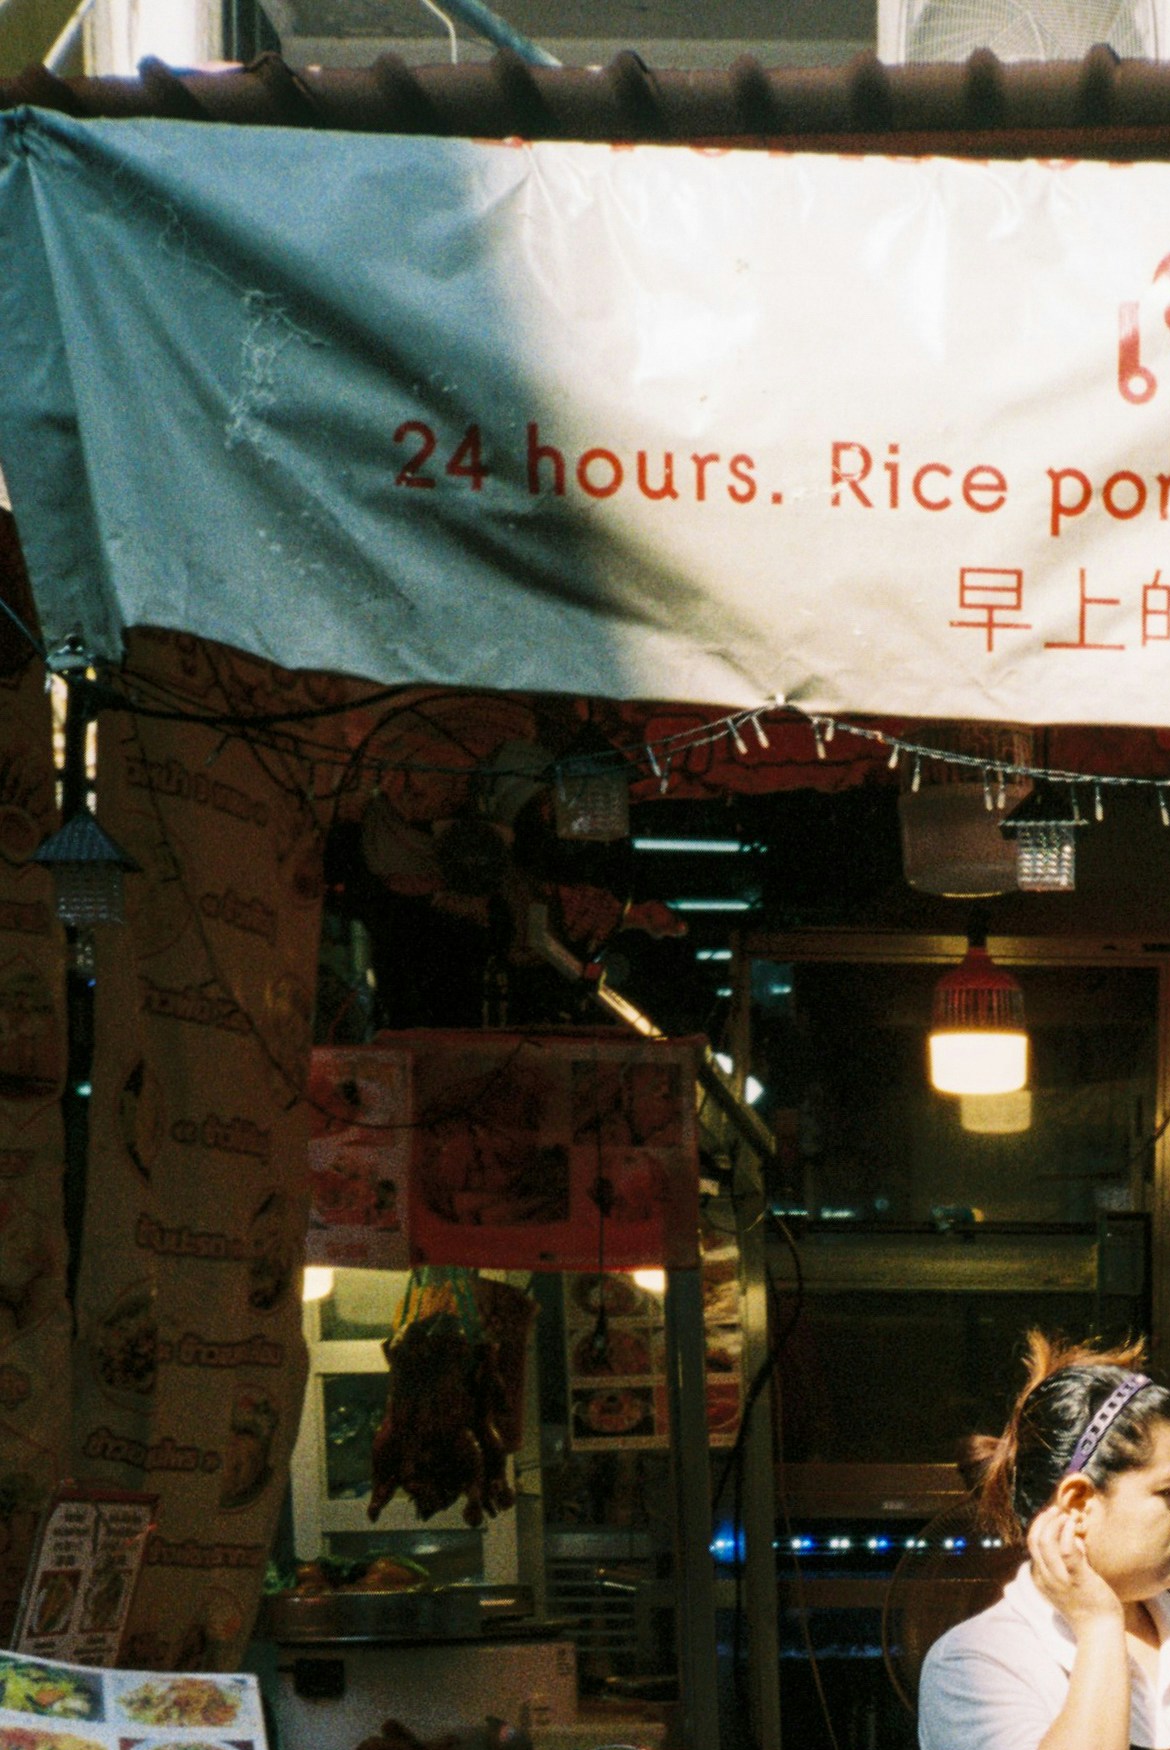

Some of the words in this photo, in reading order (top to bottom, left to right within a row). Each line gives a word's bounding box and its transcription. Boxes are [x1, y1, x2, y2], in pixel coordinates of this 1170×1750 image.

[392, 420, 487, 491] 24
[527, 422, 784, 506] hours.
[831, 441, 1009, 514] Rice
